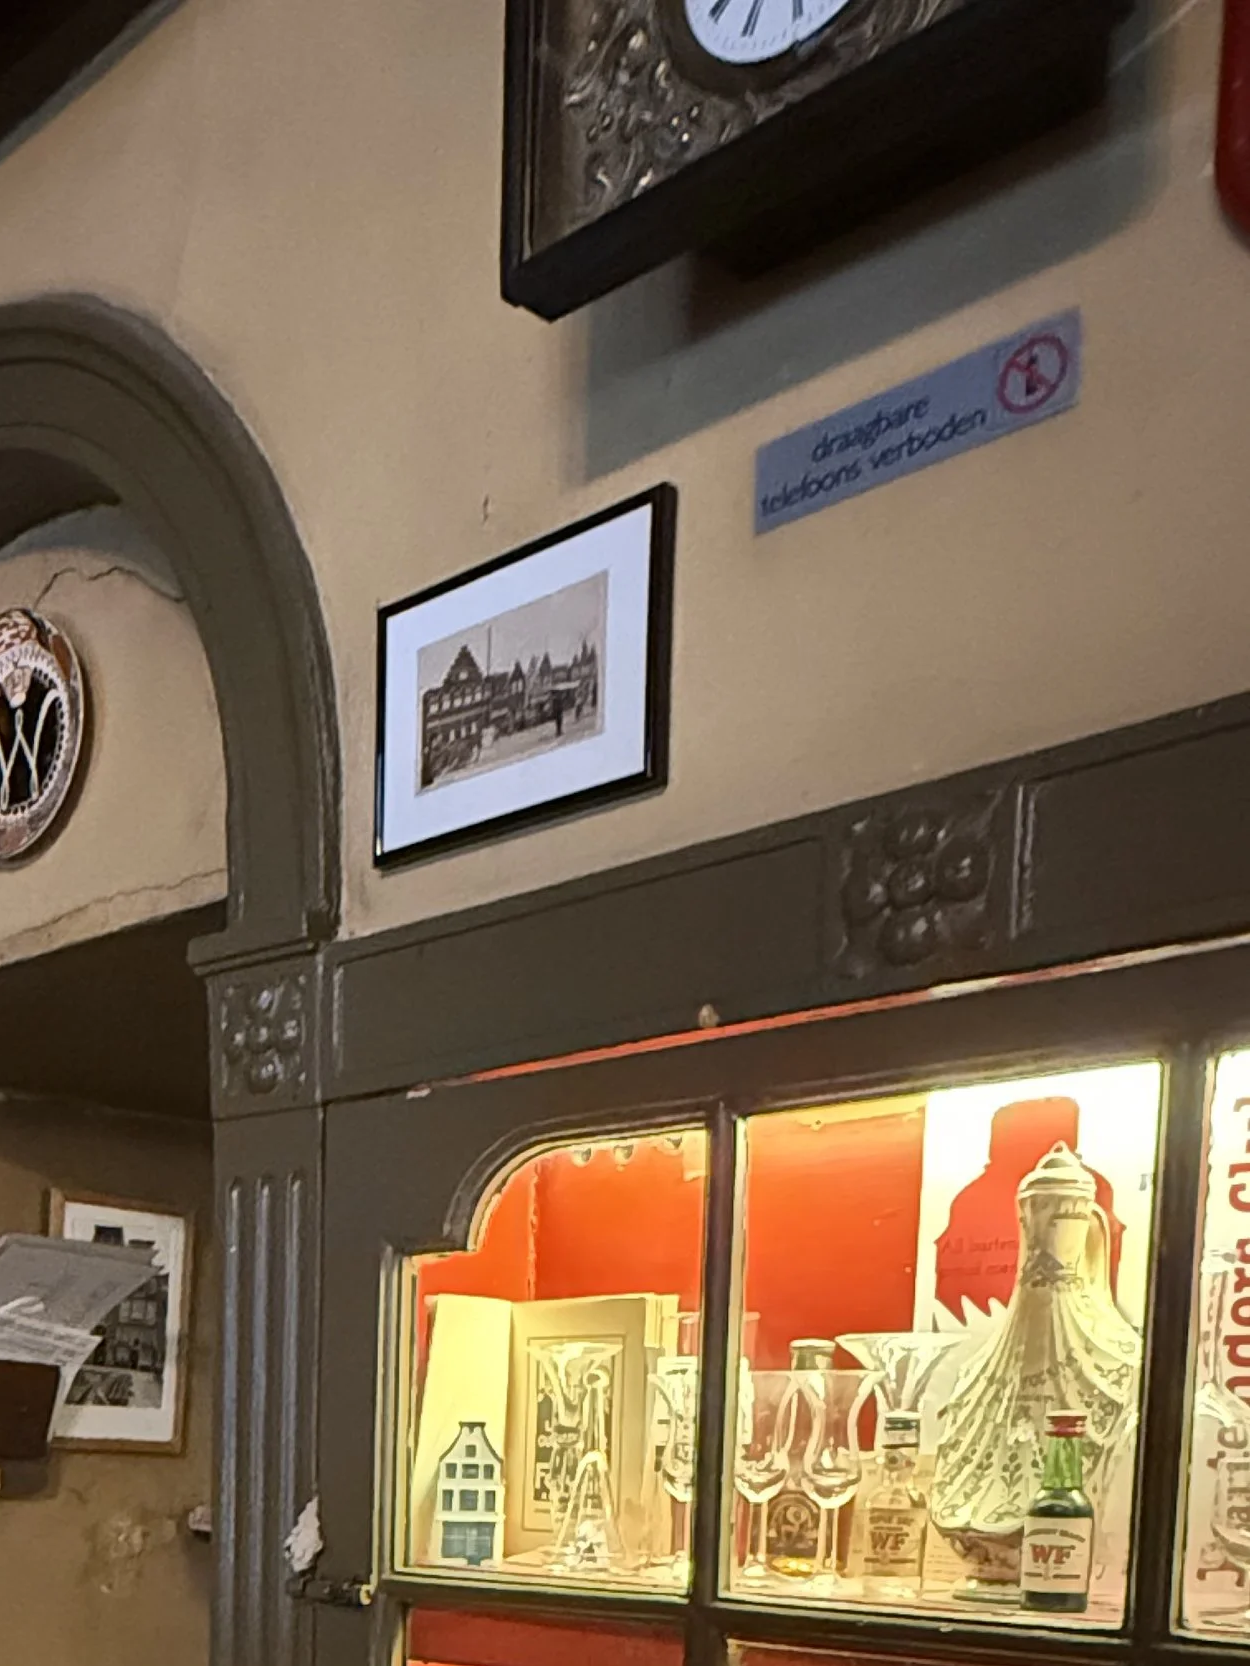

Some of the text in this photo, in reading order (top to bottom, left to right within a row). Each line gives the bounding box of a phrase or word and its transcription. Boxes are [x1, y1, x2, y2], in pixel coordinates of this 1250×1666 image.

[759, 406, 988, 517] telefoons verboden
[811, 395, 930, 464] draagbare
[1029, 1543, 1077, 1565] WF
